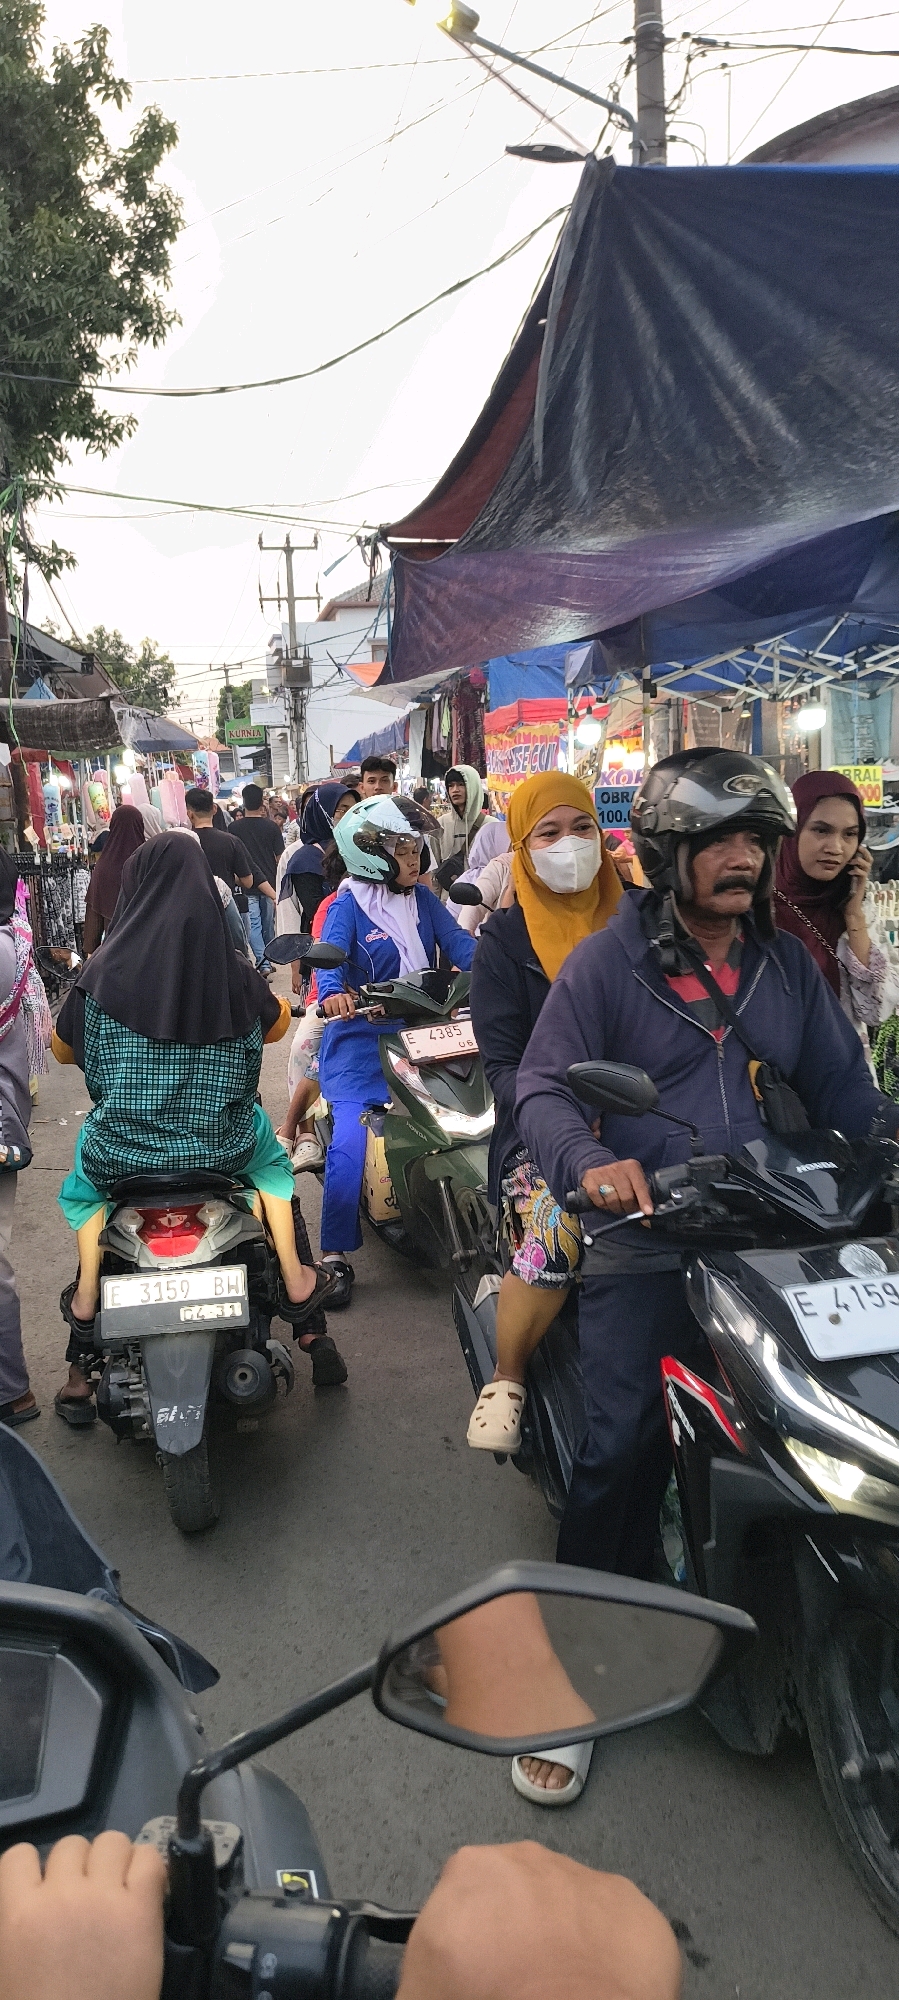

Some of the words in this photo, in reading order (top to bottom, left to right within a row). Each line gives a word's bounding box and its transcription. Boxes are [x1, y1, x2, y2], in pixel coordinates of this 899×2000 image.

[229, 729, 262, 738] KURNIA
[406, 1033, 416, 1044] E
[429, 1025, 462, 1040] 4385
[406, 1121, 428, 1142] HONDA
[796, 1161, 838, 1173] HONDA
[110, 1285, 122, 1307] E
[140, 1279, 190, 1304] 3159
[214, 1275, 239, 1296] BW
[793, 1292, 818, 1317] E
[834, 1282, 899, 1312] 4159
